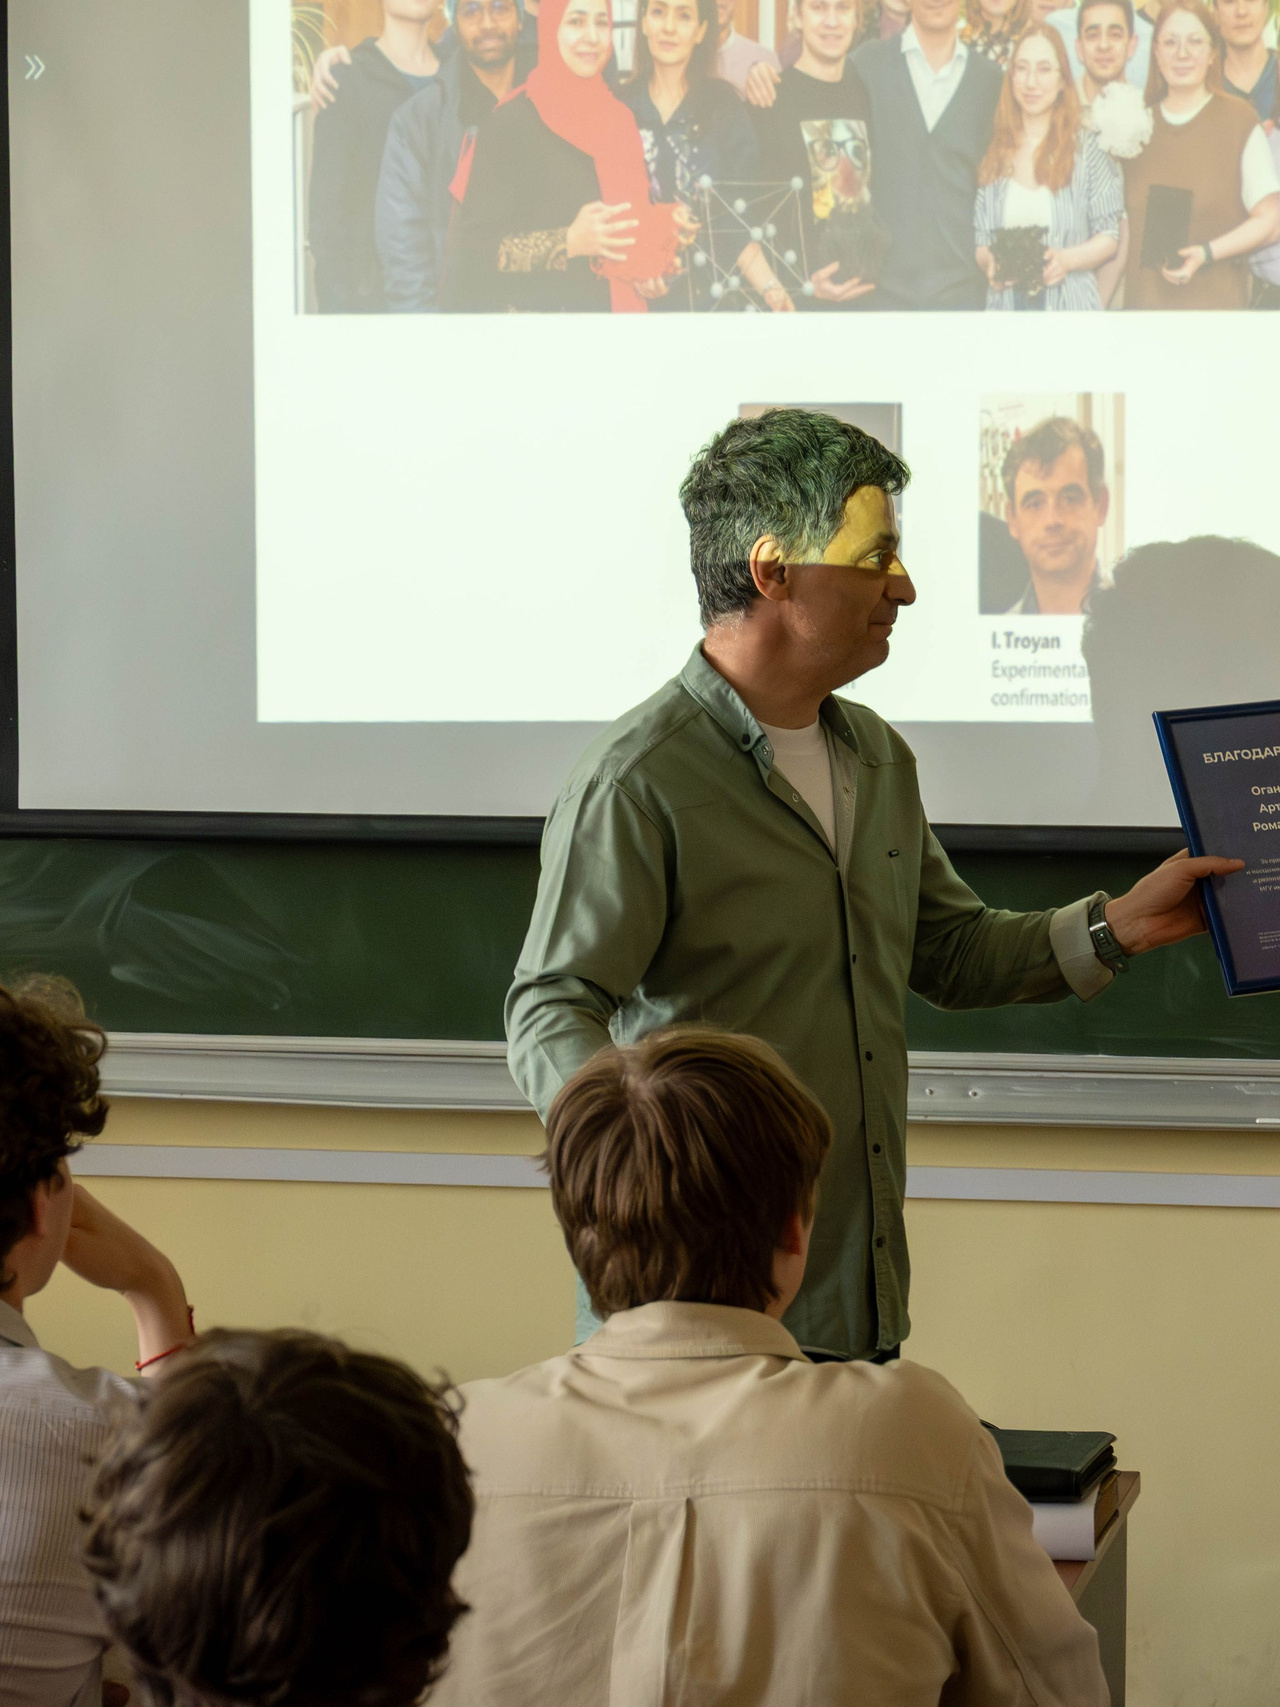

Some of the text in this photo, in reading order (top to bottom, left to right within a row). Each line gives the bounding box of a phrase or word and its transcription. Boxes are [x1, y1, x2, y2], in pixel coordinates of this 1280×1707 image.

[992, 631, 1060, 654] I. Troyan
[990, 687, 1088, 706] confirmation
